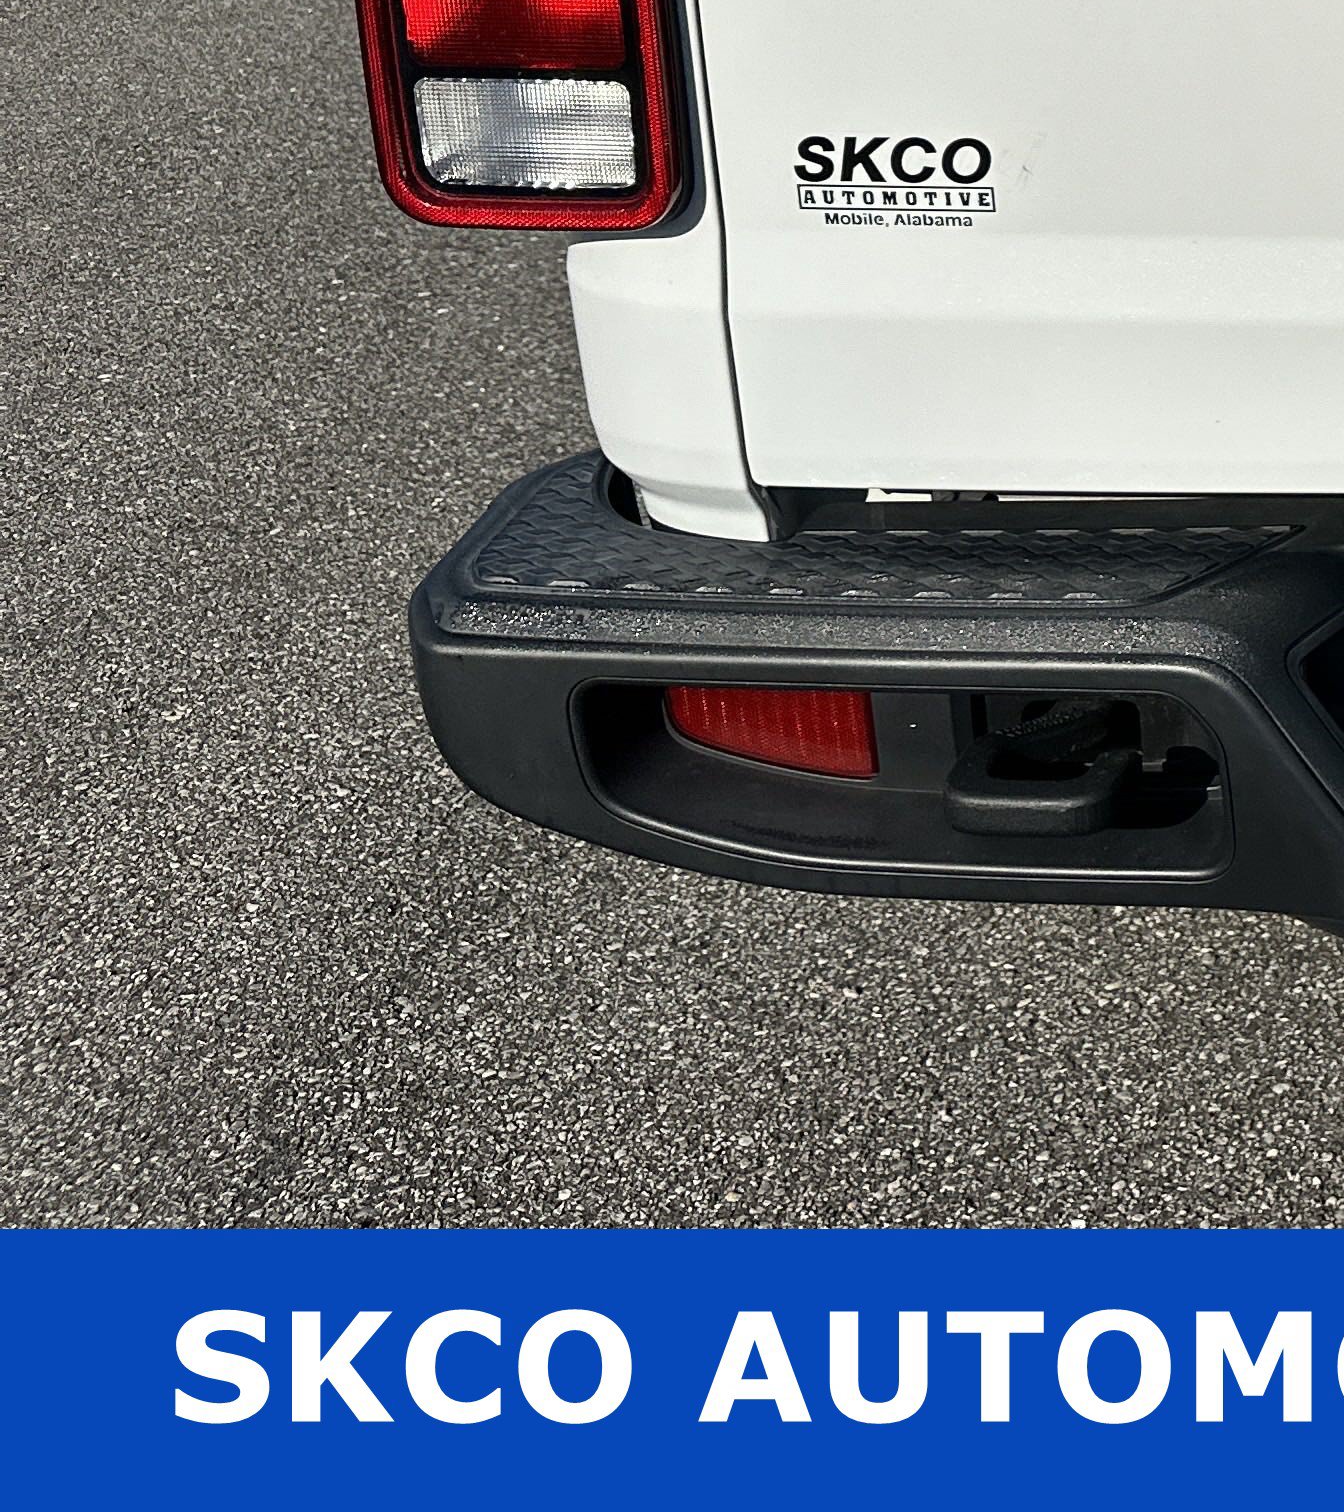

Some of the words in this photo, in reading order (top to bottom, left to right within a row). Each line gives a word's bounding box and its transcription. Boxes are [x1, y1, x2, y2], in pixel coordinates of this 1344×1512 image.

[793, 135, 992, 184] SKCO
[803, 190, 991, 207] AUTOMOTIVE
[824, 212, 890, 228] Mobile,
[894, 213, 973, 227] Alabama
